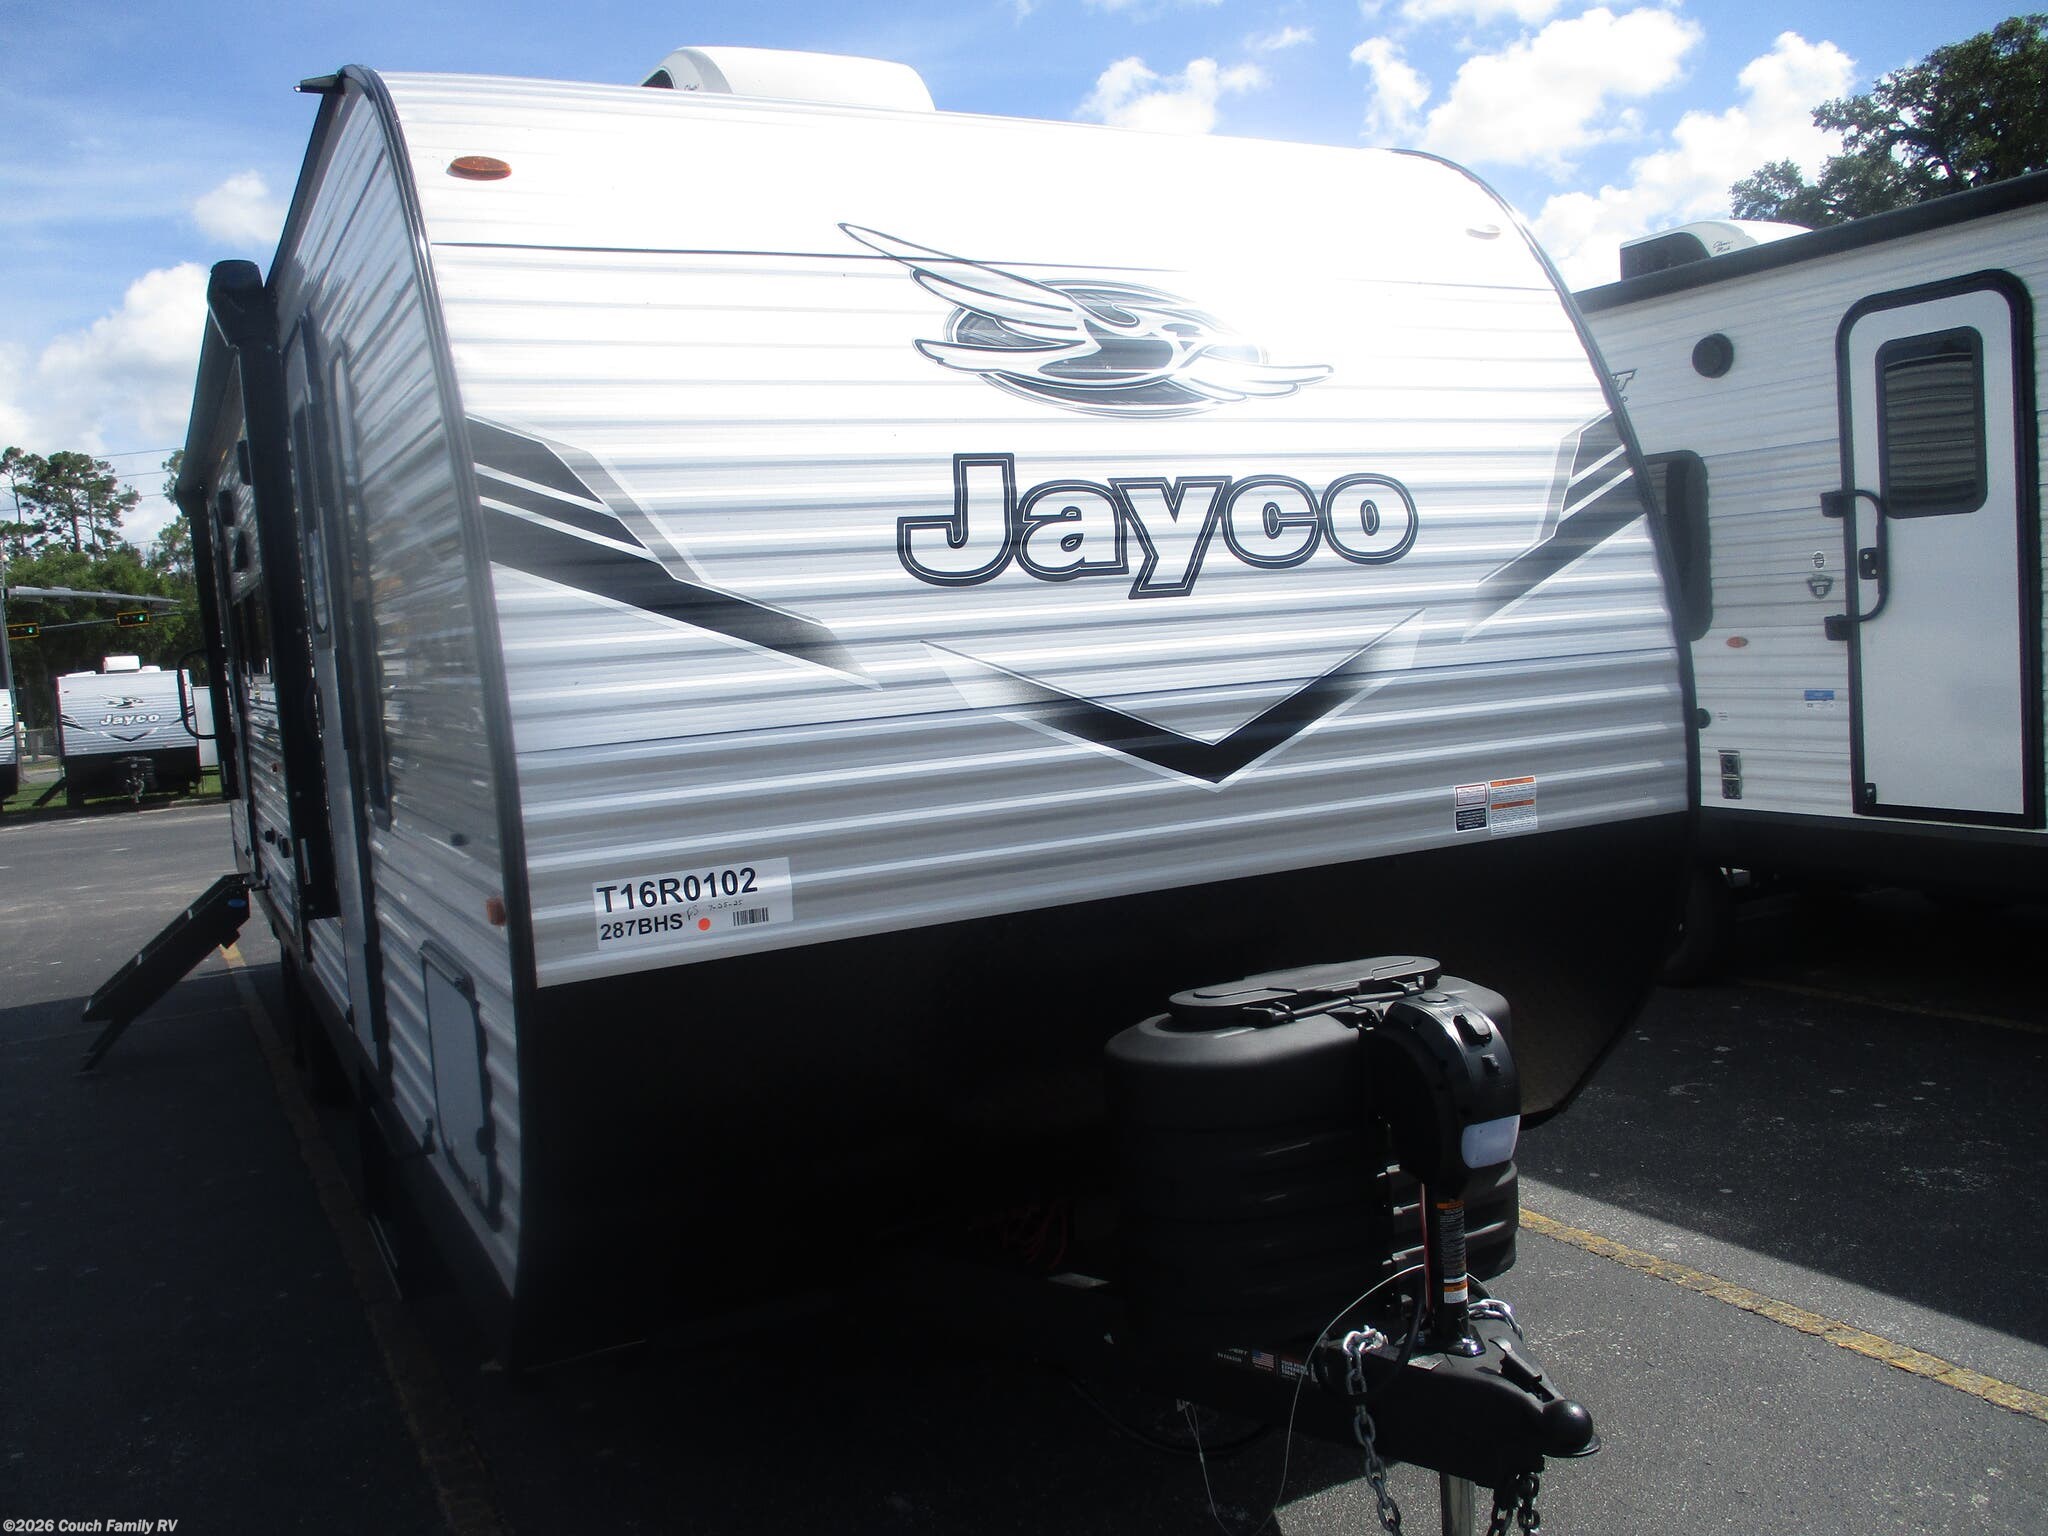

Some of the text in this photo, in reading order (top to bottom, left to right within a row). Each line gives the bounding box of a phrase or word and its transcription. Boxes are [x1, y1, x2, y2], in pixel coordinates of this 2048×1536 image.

[896, 452, 1418, 600] Jayco
[100, 713, 161, 726] Jayco
[596, 867, 758, 913] T16R0102
[600, 913, 683, 941] 287BHS
